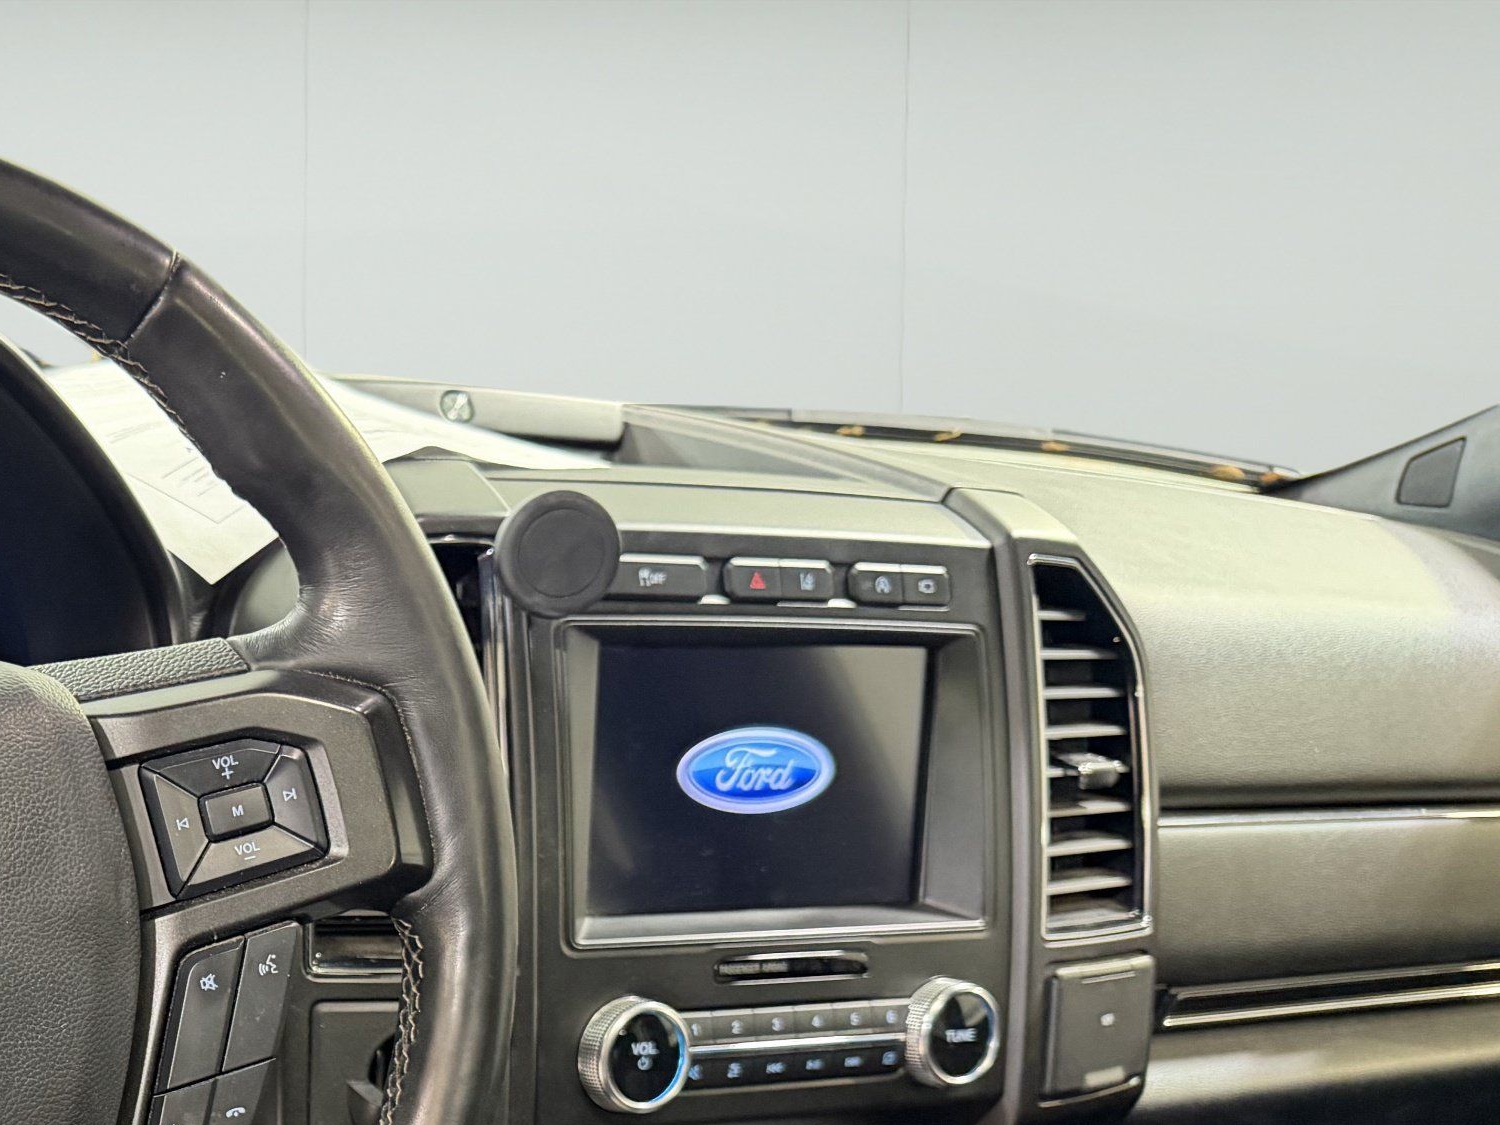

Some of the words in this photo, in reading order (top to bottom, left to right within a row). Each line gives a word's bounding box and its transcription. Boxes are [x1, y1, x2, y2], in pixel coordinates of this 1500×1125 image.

[212, 755, 238, 769] VOL
[715, 747, 796, 791] Ford
[232, 804, 244, 816] M
[234, 842, 260, 855] VOL
[945, 1028, 978, 1043] TUNE
[631, 1041, 659, 1056] VOL
